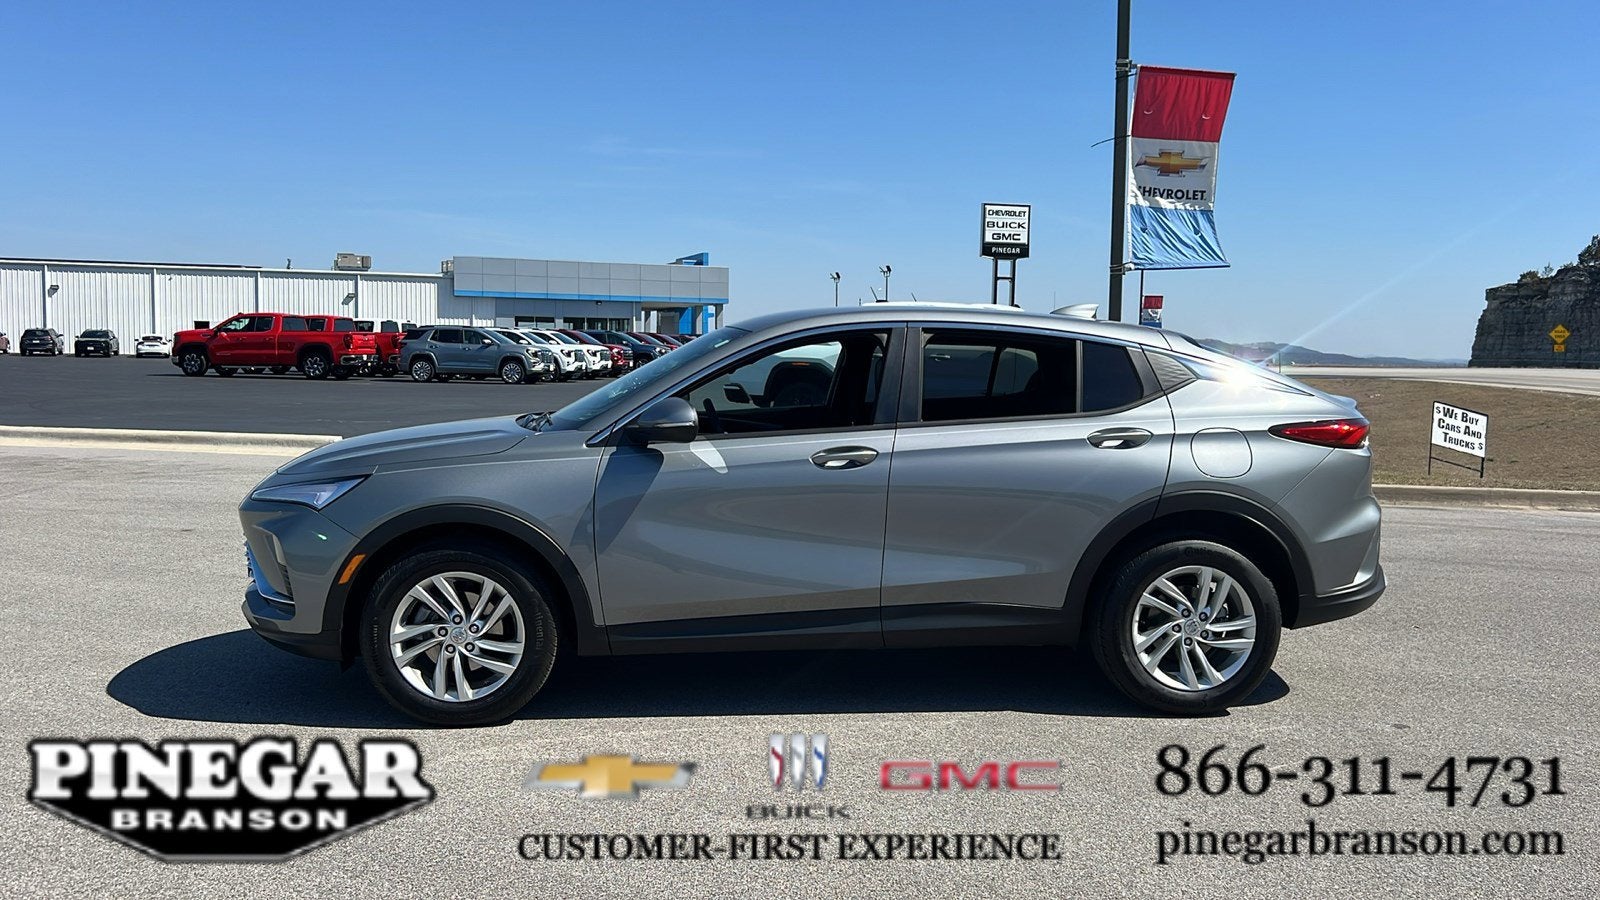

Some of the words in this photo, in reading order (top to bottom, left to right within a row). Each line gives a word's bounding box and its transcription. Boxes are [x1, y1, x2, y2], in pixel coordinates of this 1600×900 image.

[987, 209, 1027, 217] CHEVROLET
[986, 220, 1027, 229] BUICK
[991, 232, 1021, 241] GMC
[991, 246, 1020, 254] PINEGAR
